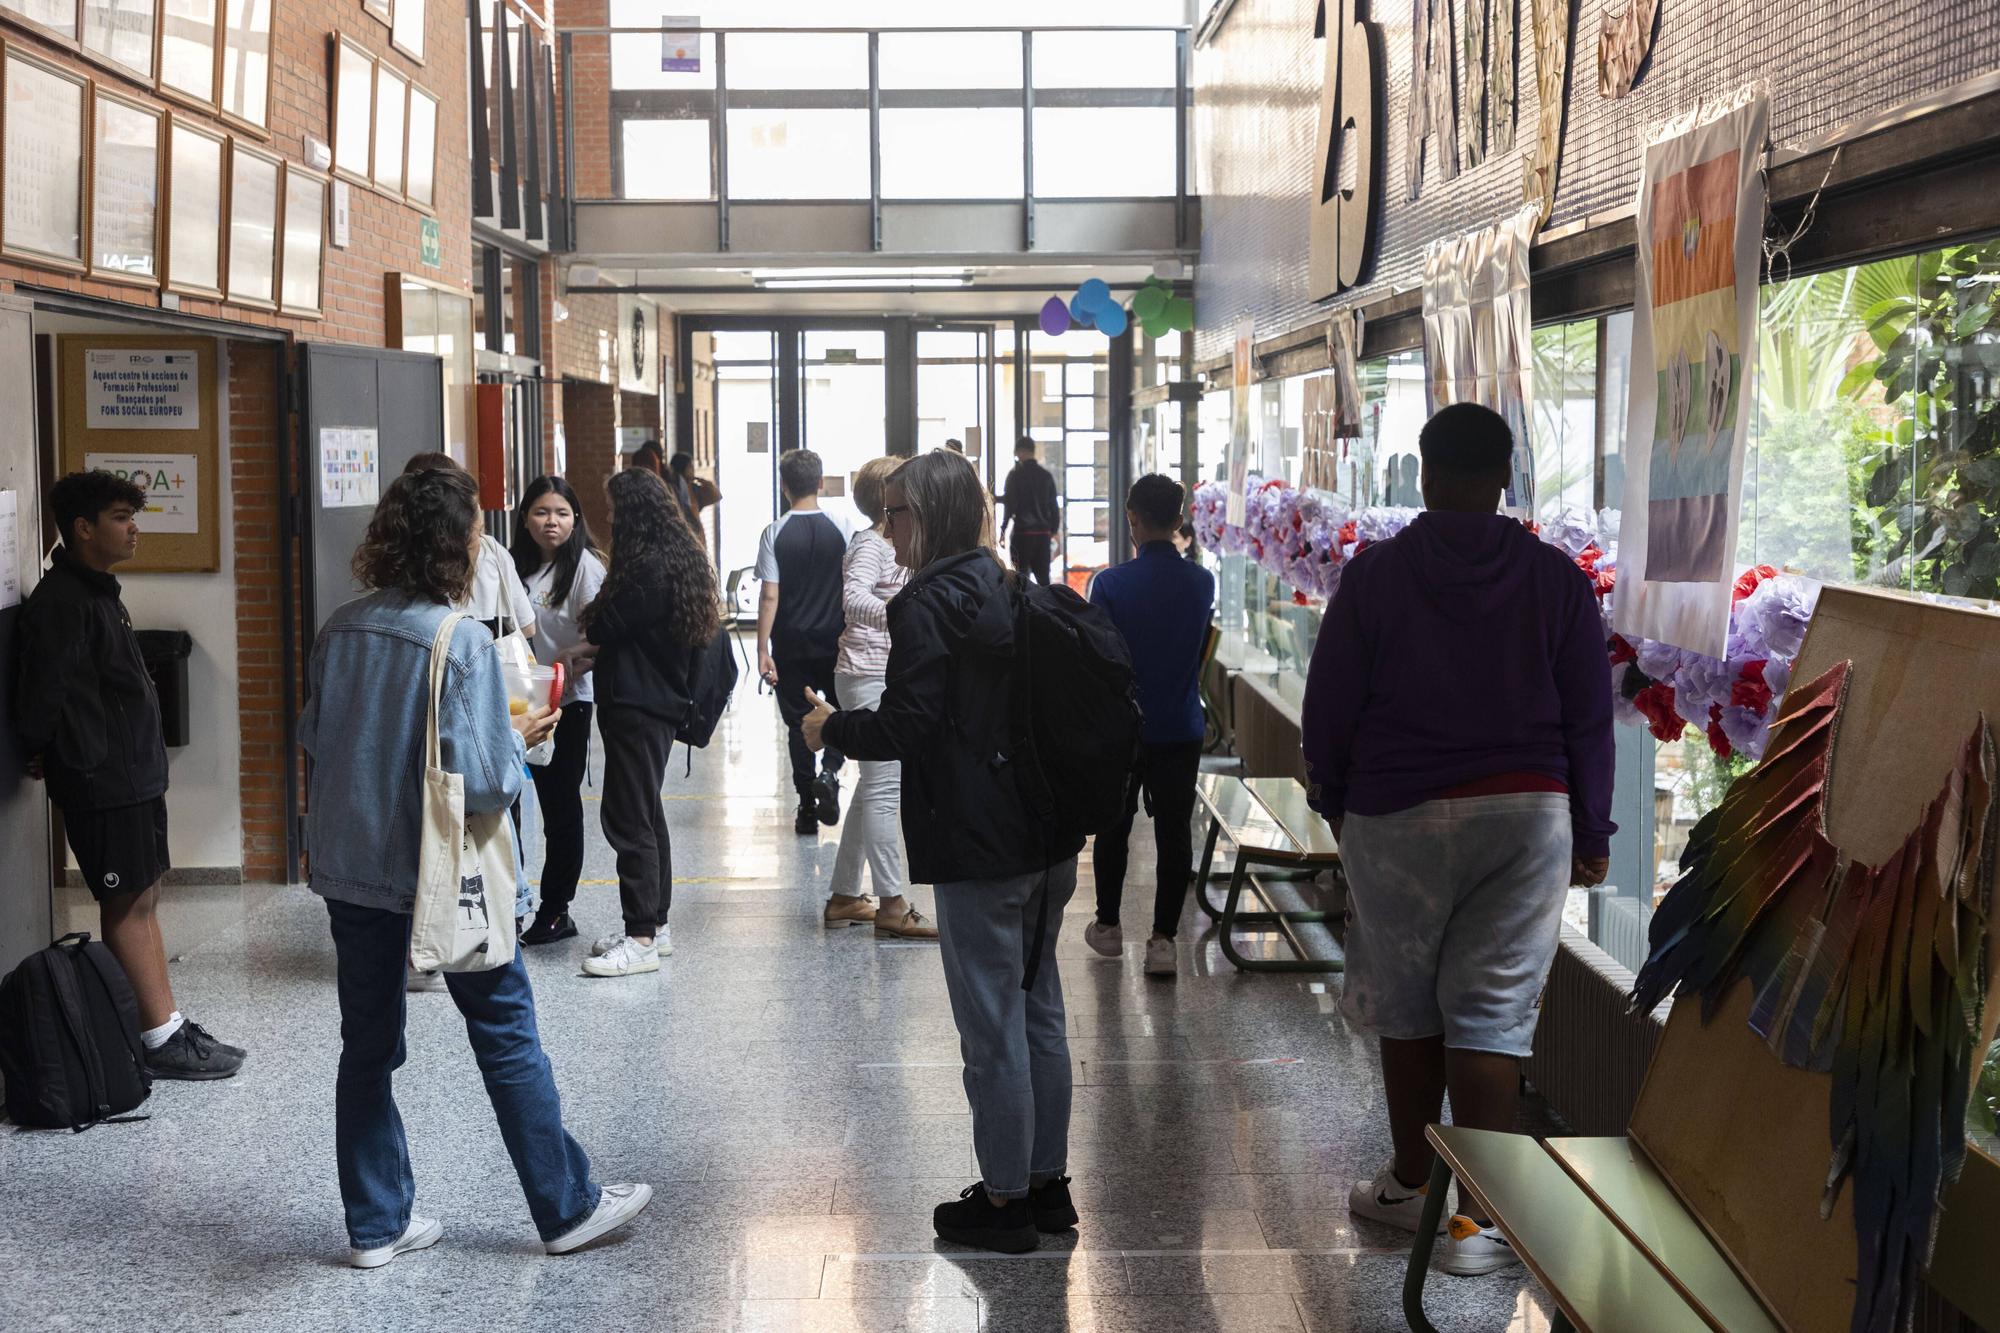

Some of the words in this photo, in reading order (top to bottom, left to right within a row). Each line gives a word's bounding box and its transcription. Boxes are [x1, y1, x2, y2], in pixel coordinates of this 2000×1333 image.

[93, 370, 117, 382] Aquest
[118, 371, 140, 380] centre
[142, 370, 149, 380] té
[151, 370, 178, 380] accions
[180, 370, 188, 380] de
[103, 382, 135, 392] Formació
[137, 382, 179, 392] Professional
[116, 394, 154, 405] finançades
[156, 394, 167, 405] pel
[101, 406, 119, 416] FONS
[121, 406, 147, 416] SOCIAL
[149, 406, 182, 416] EUROPEU
